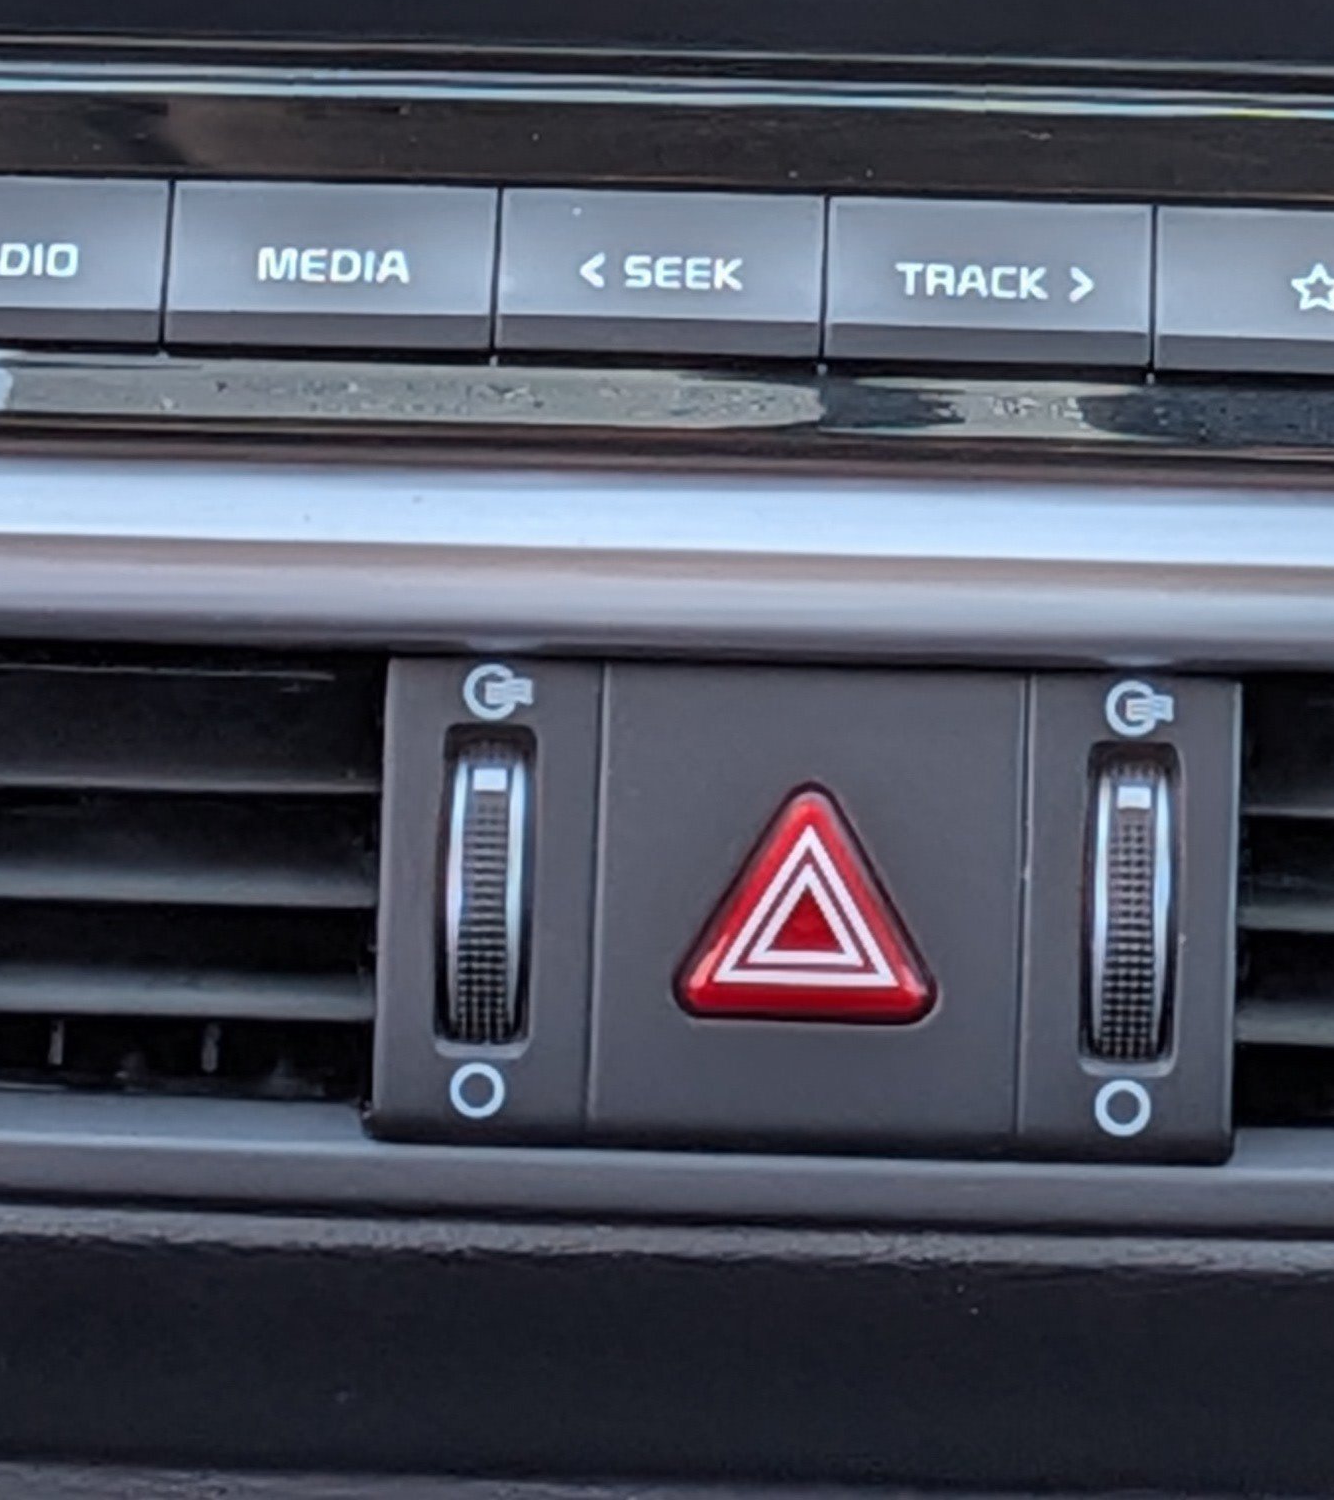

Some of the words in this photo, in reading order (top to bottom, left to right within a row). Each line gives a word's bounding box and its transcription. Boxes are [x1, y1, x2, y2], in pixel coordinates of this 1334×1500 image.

[257, 247, 411, 285] MEDIA
[623, 255, 744, 292] SEEK
[895, 261, 1050, 301] TRACK
